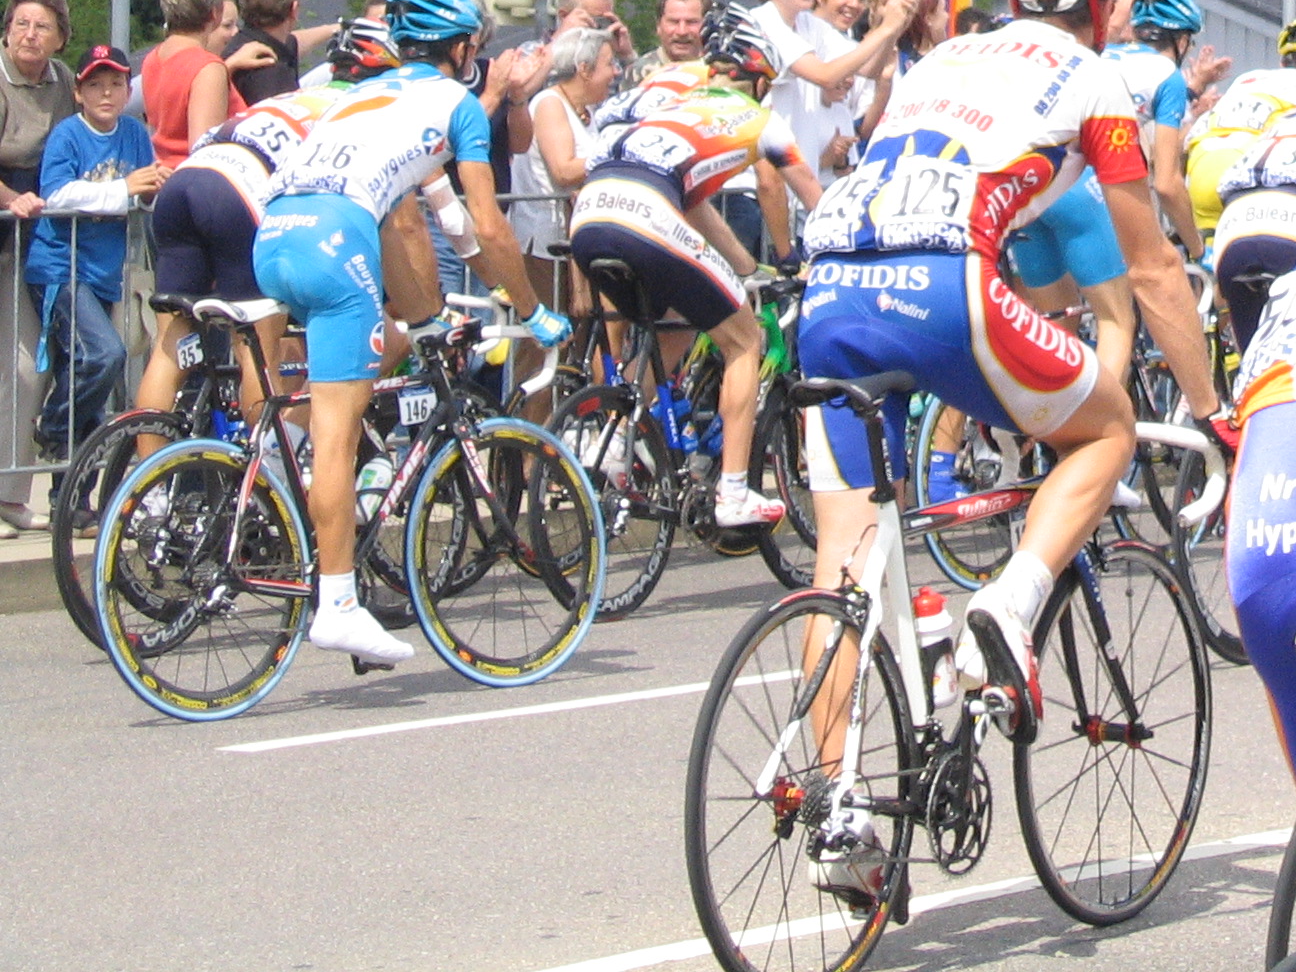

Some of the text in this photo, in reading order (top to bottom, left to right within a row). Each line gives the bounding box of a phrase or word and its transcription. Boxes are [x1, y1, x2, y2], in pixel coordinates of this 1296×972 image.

[951, 104, 994, 132] 300
[250, 122, 290, 152] 35
[596, 192, 652, 219] Balears
[891, 168, 964, 218] 125
[807, 263, 930, 291] COFIDIS
[891, 299, 931, 321] Nalini
[988, 277, 1083, 367] COFIDIS
[179, 347, 197, 368] 35
[405, 398, 428, 422] 146
